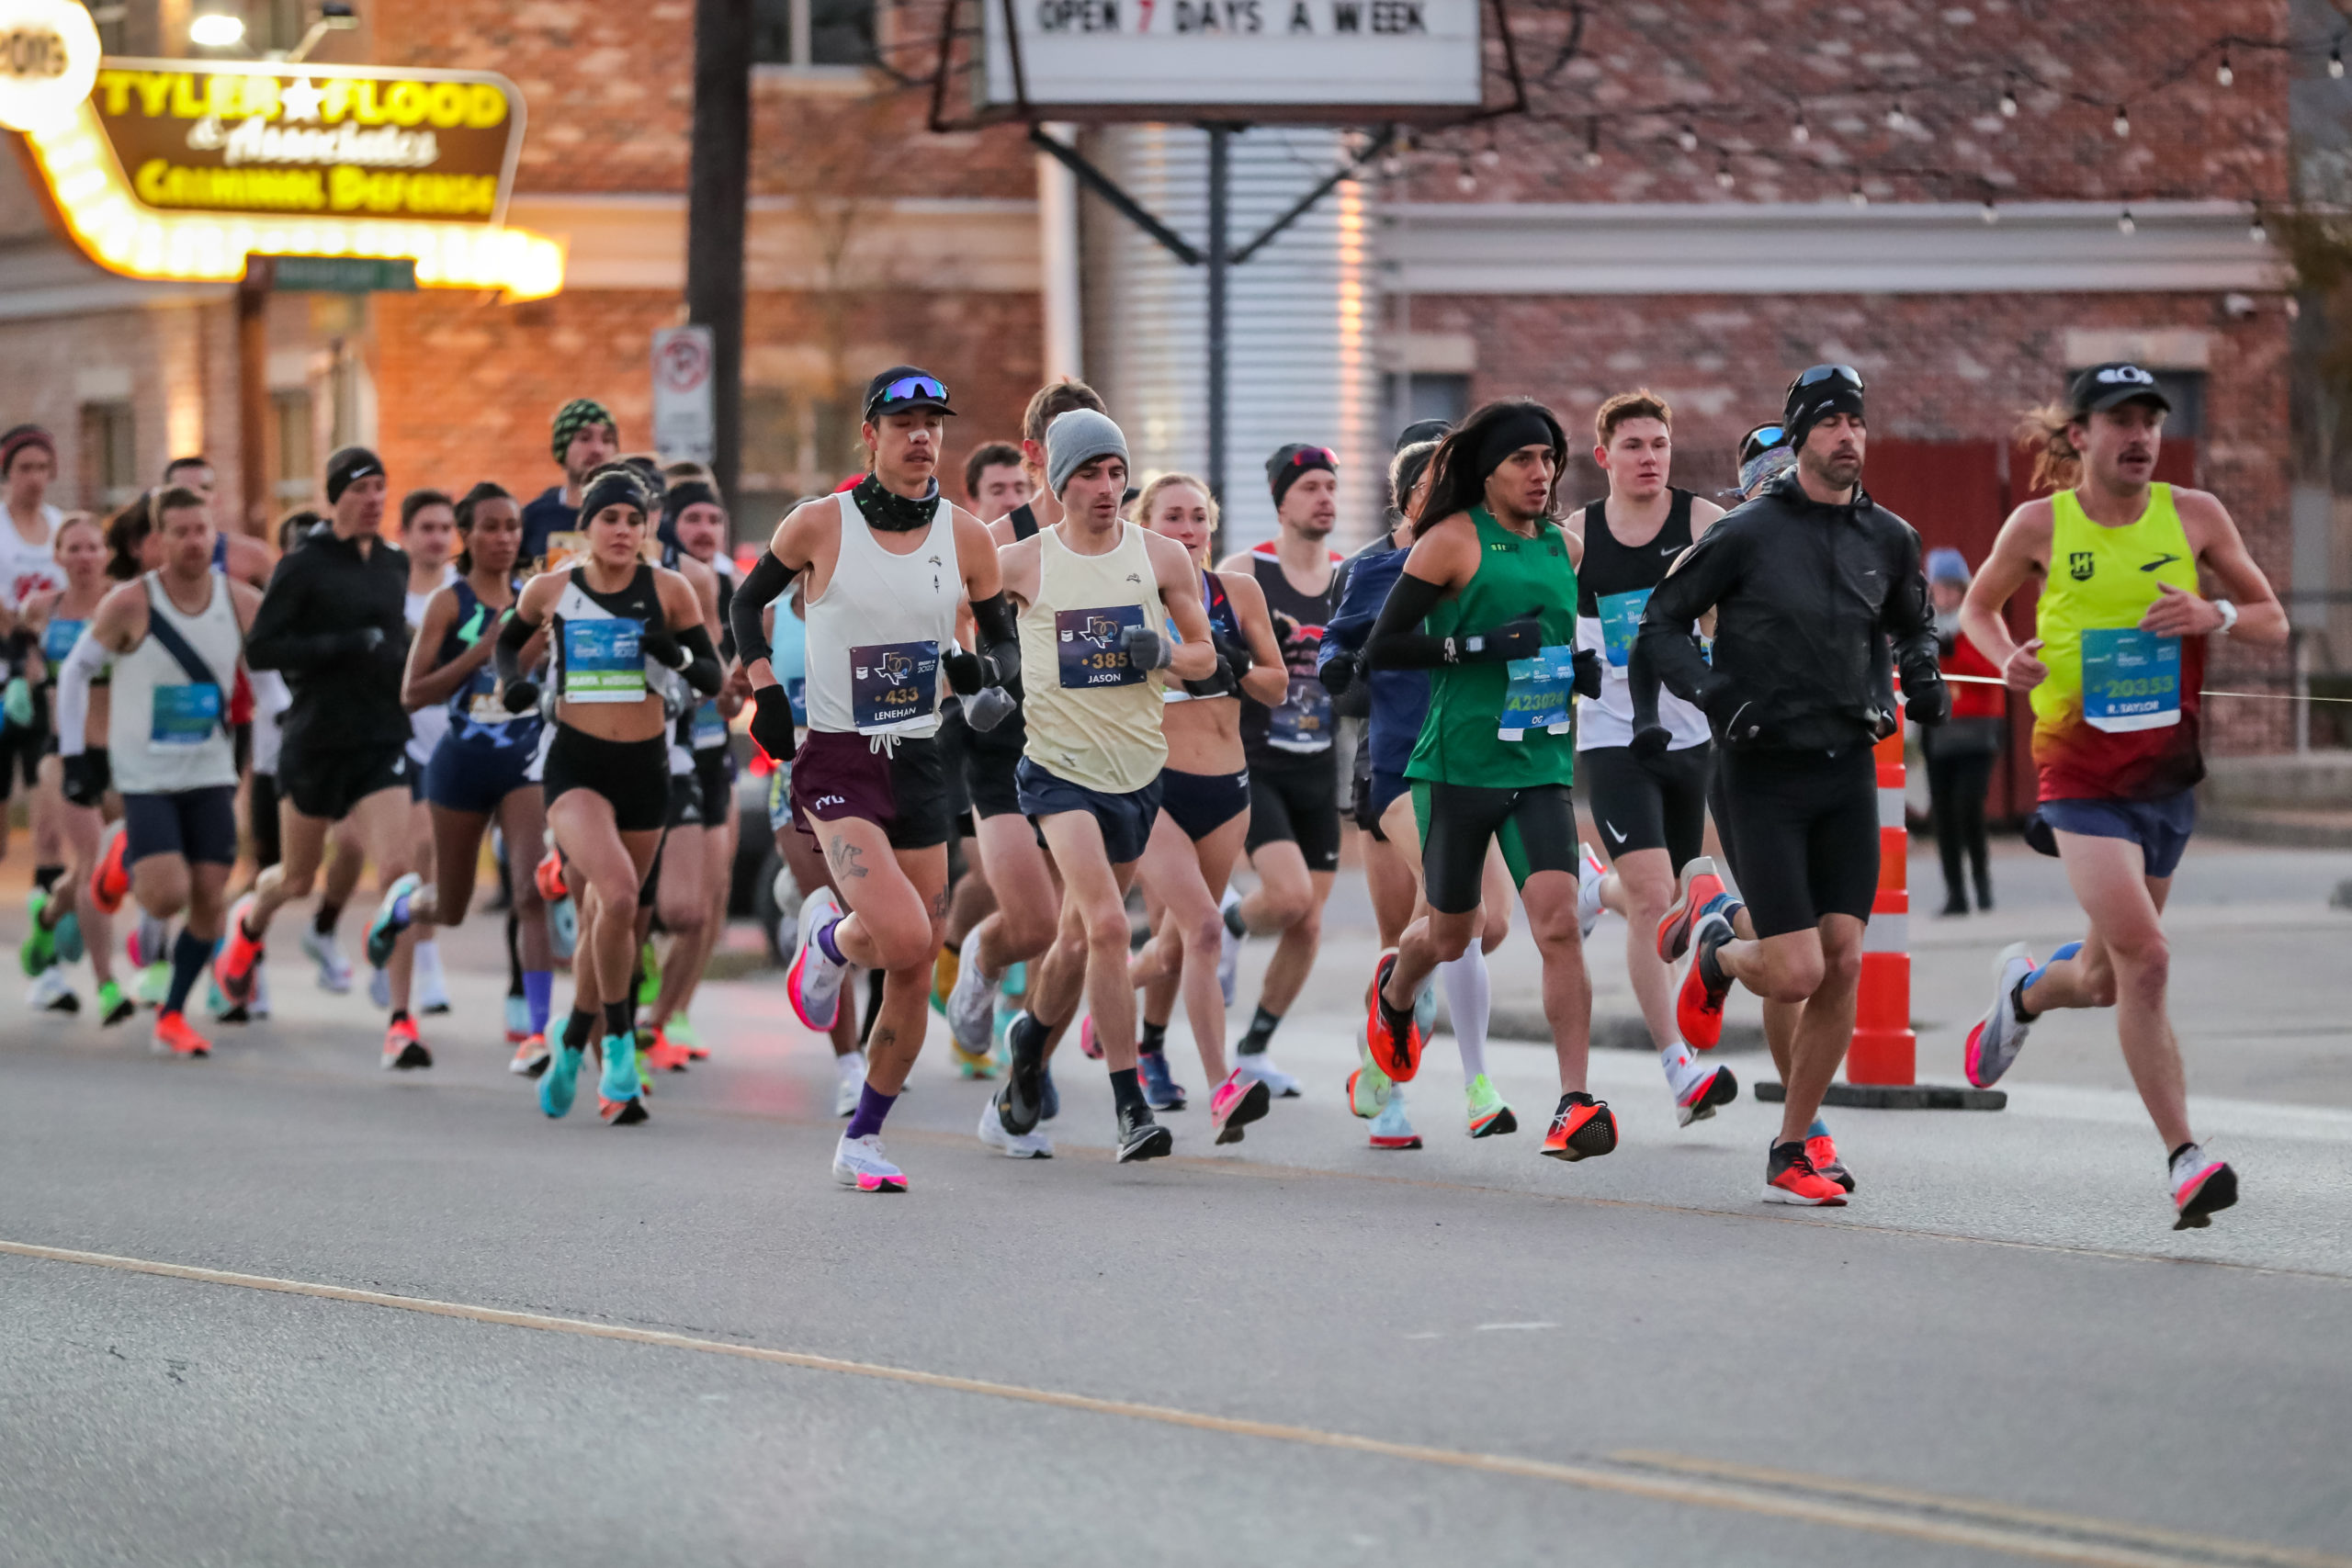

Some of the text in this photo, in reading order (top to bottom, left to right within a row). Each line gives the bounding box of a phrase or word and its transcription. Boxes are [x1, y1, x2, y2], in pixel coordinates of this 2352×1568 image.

[1037, 0, 1427, 35] OPEN 7 DAYS A WEEK
[97, 69, 508, 130] TYLER FLOOD
[1092, 651, 1129, 670] 385
[1088, 673, 1122, 683] JASON
[884, 686, 919, 705] 433
[874, 706, 917, 721] LENEHAN
